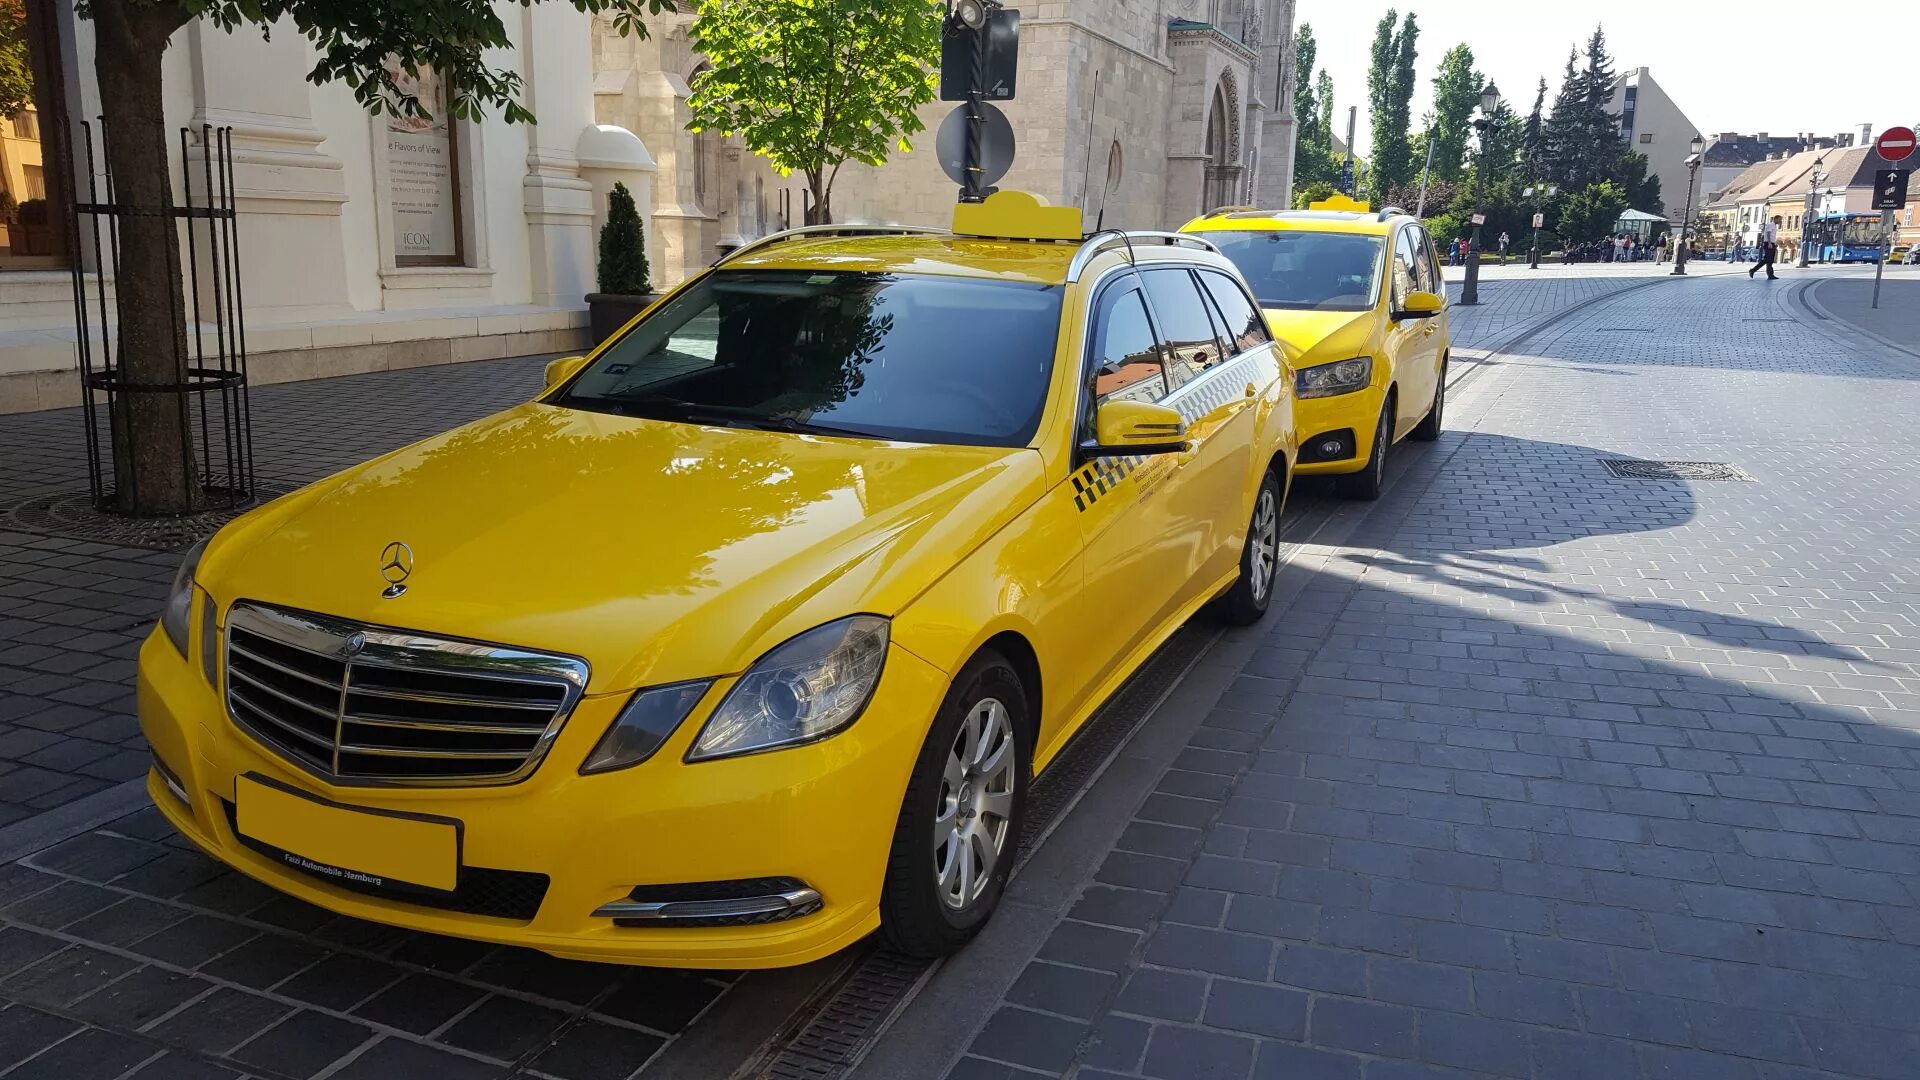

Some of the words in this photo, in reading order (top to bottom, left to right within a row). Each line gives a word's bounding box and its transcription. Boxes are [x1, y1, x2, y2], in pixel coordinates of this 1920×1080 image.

[394, 141, 416, 152] Flavors
[417, 144, 425, 153] of
[426, 144, 441, 154] View
[403, 232, 430, 245] ICON
[301, 860, 342, 876] Automobile
[344, 871, 382, 885] Hamburg
